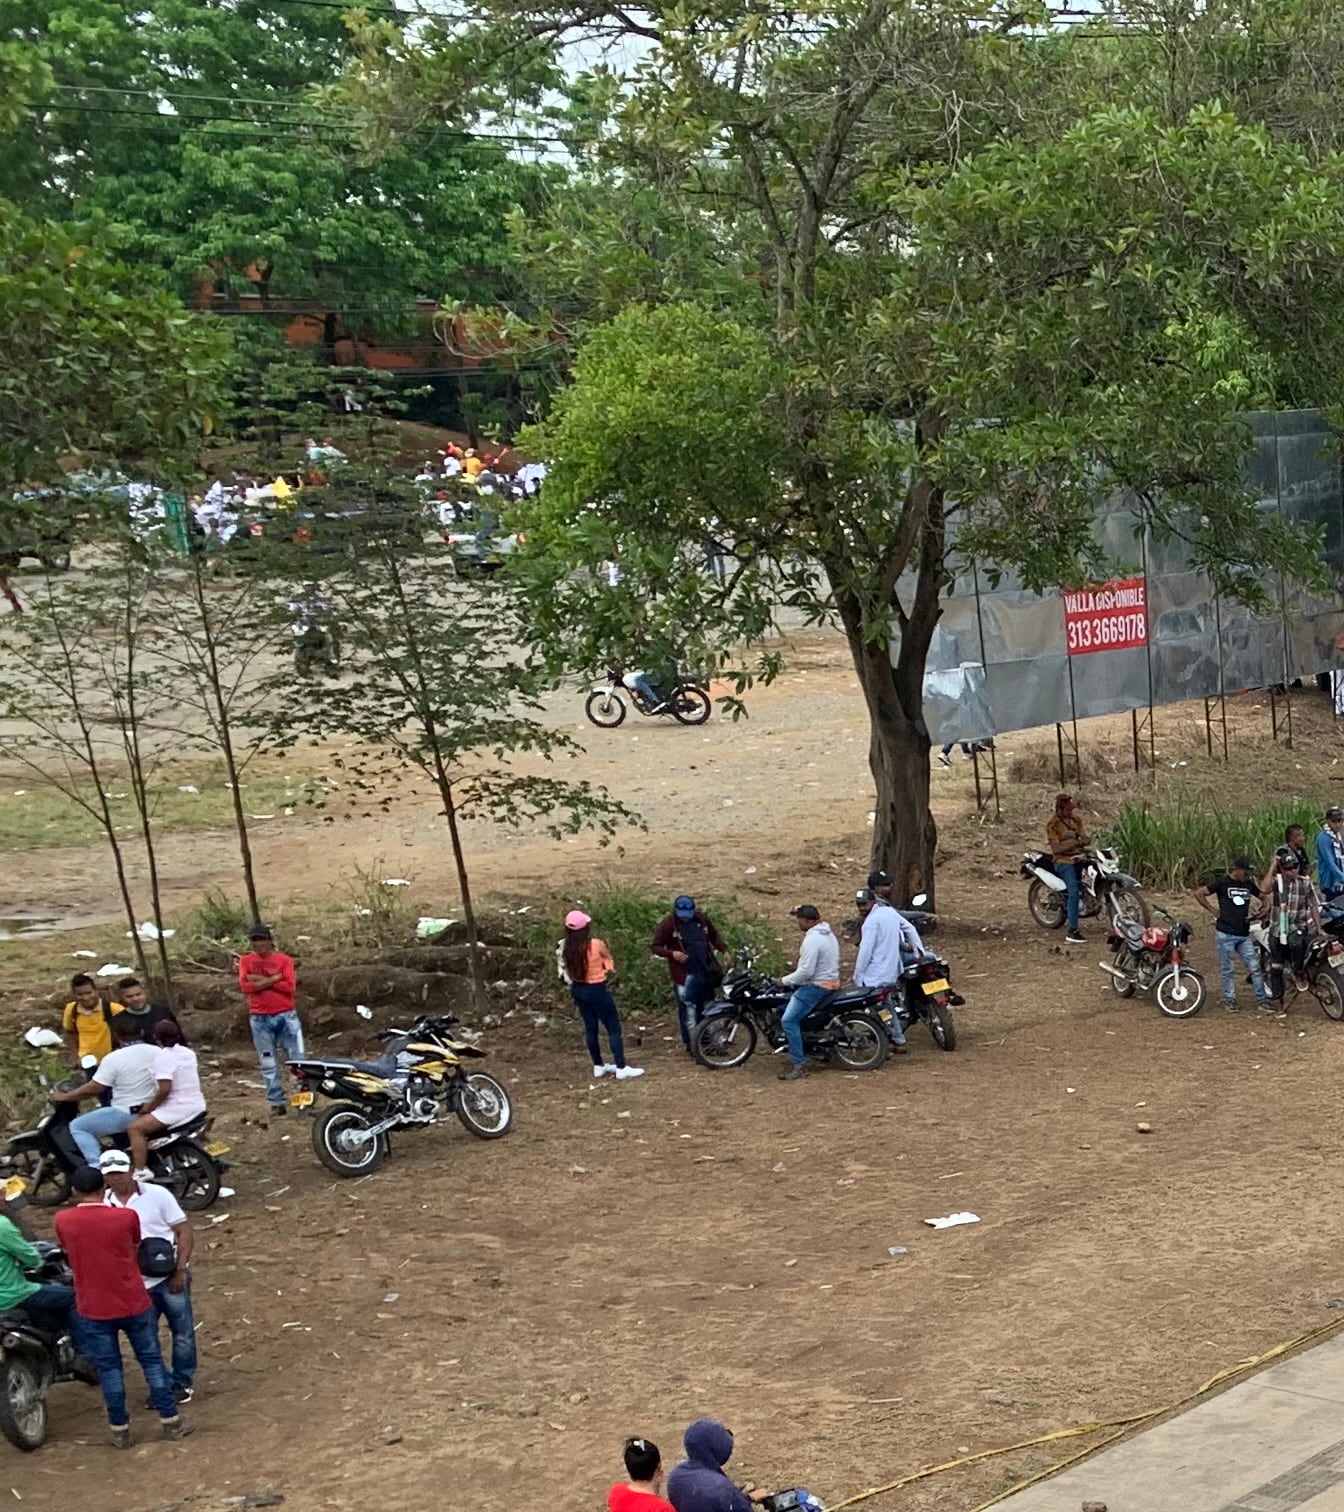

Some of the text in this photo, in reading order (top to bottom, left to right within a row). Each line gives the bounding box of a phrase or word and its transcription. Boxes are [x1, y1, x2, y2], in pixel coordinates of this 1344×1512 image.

[1064, 587, 1144, 613] VALLA DISPONIBLE
[1068, 613, 1146, 649] 313 3669178
